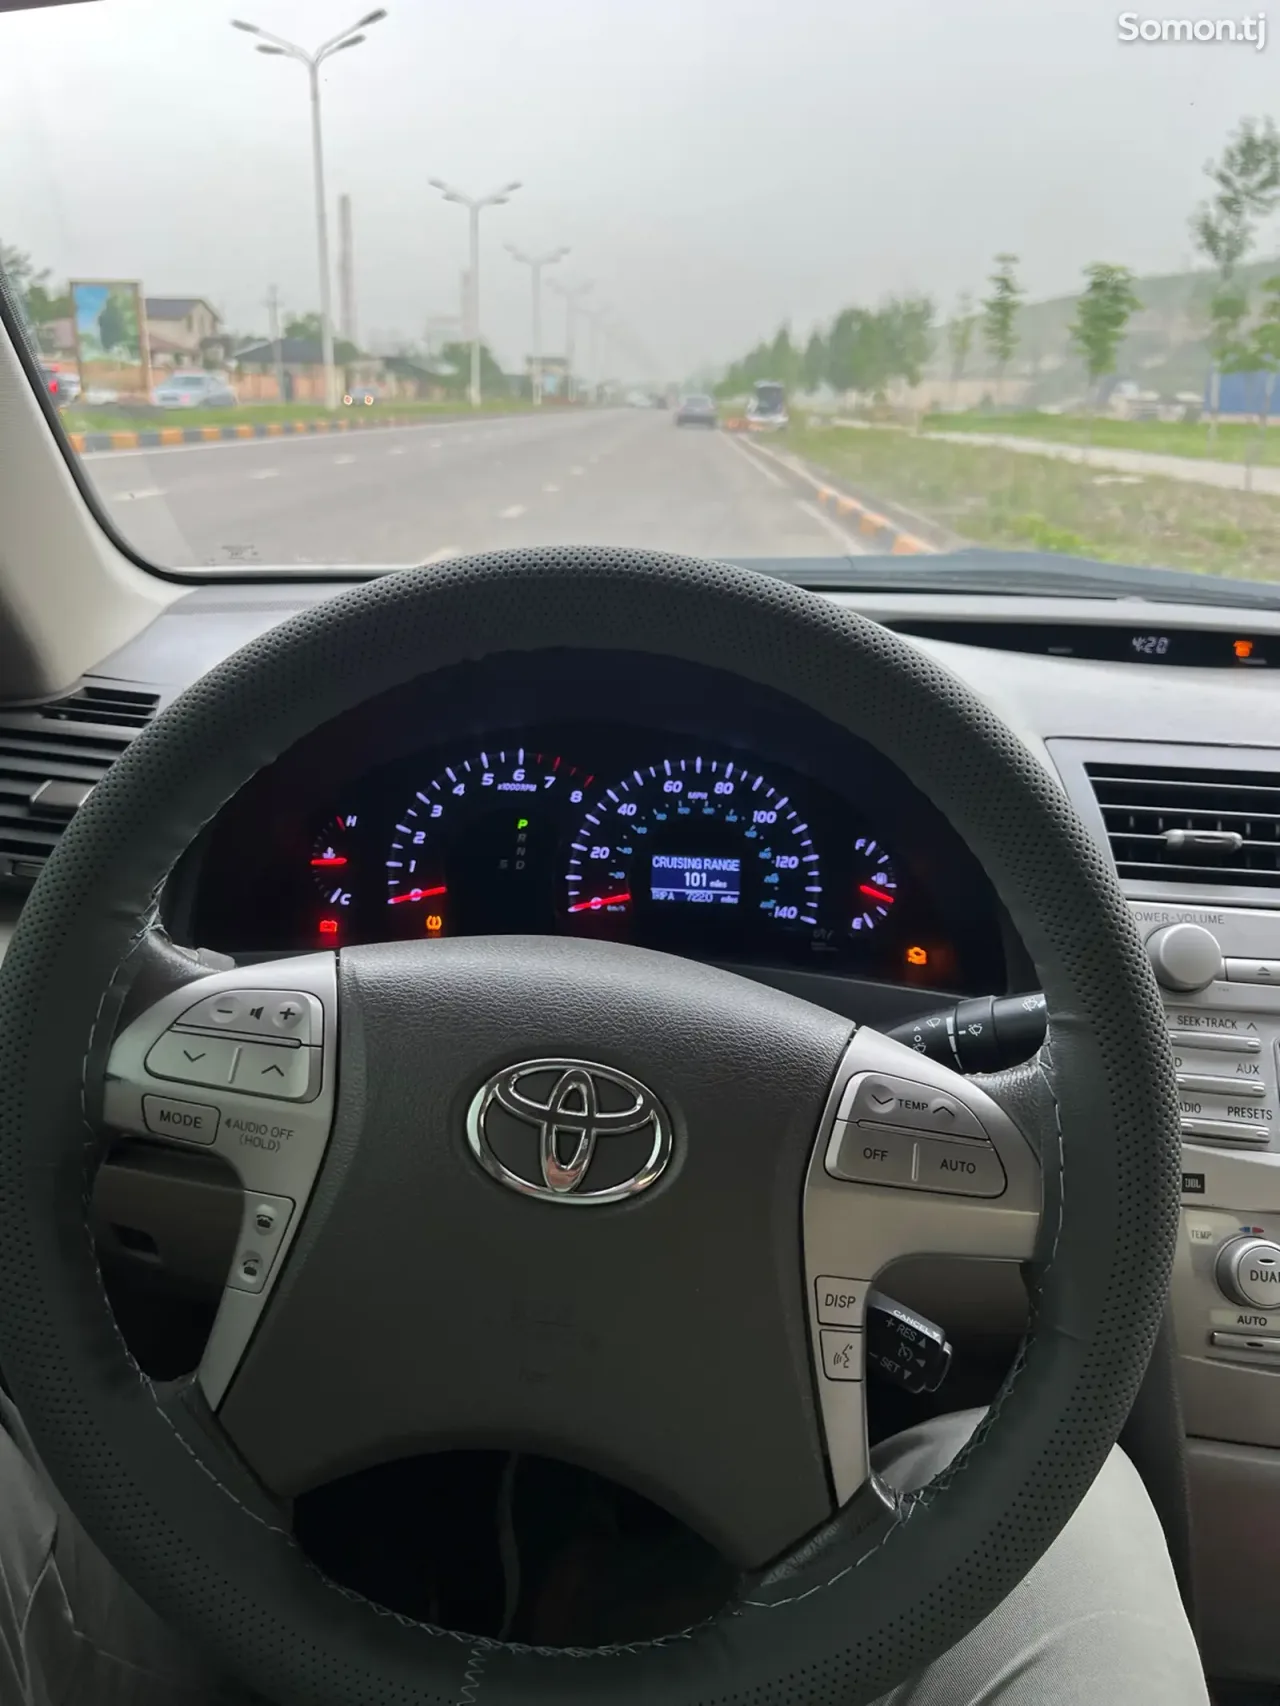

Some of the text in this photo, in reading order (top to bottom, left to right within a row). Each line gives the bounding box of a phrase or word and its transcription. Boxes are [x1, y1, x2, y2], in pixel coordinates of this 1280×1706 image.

[481, 773, 495, 786] 5
[512, 768, 526, 781] 6
[544, 776, 556, 789] 7
[663, 780, 683, 793] 60
[714, 782, 735, 795] 80
[452, 783, 466, 796] 4
[570, 790, 583, 803] 8
[430, 804, 443, 817] 3
[617, 803, 637, 816] 40
[346, 815, 357, 827] H
[752, 810, 778, 824] 100
[517, 819, 529, 829] P
[413, 831, 426, 844] 2
[855, 838, 867, 850] F
[590, 846, 610, 859] 20
[409, 860, 416, 872] 1
[652, 856, 740, 871] CRUISING RANGE
[775, 855, 799, 869] 120
[684, 872, 707, 887] 101
[340, 893, 352, 905] C
[774, 906, 798, 919] 140
[1236, 1063, 1260, 1075] AUX
[898, 1099, 929, 1111] TEMP
[1227, 1105, 1273, 1120] PRESETS
[159, 1110, 203, 1129] MODE
[232, 1119, 295, 1141] AUDIO OFF
[239, 1133, 281, 1154] (HOLD)
[862, 1147, 888, 1162] OFF
[939, 1158, 977, 1175] AUTO
[1191, 1229, 1212, 1240] TEMP
[824, 1293, 857, 1309] DISP
[893, 1309, 932, 1338] CANCEL
[1237, 1315, 1268, 1327] AUTO
[896, 1323, 918, 1342] RES
[879, 1355, 901, 1373] SET
